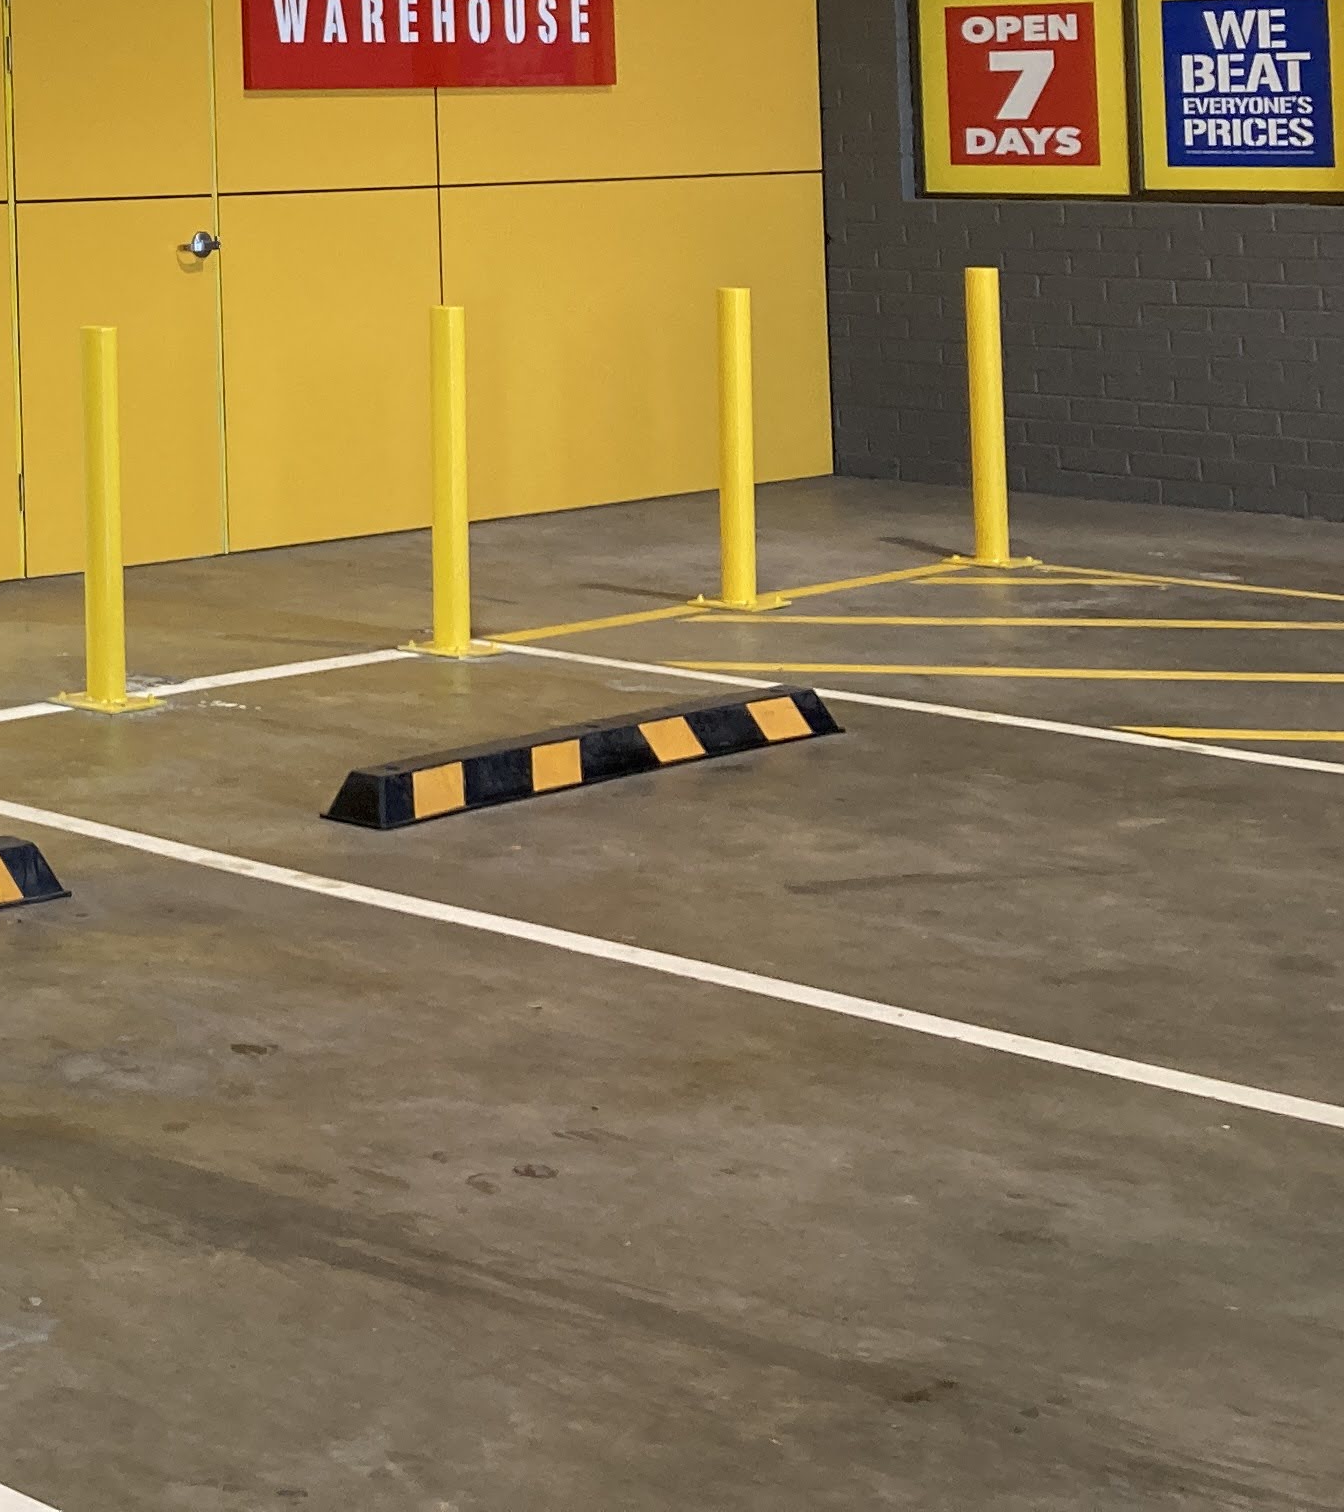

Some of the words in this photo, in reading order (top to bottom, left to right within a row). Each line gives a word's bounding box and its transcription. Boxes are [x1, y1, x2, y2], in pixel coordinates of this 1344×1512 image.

[961, 13, 1079, 44] OPEN
[1203, 8, 1286, 51] WE
[988, 49, 1055, 121] 7
[1181, 51, 1311, 94] BEAT
[1183, 95, 1313, 116] EVERYONE'S
[965, 127, 1082, 156] DAYS
[1184, 118, 1315, 148] PRICES
